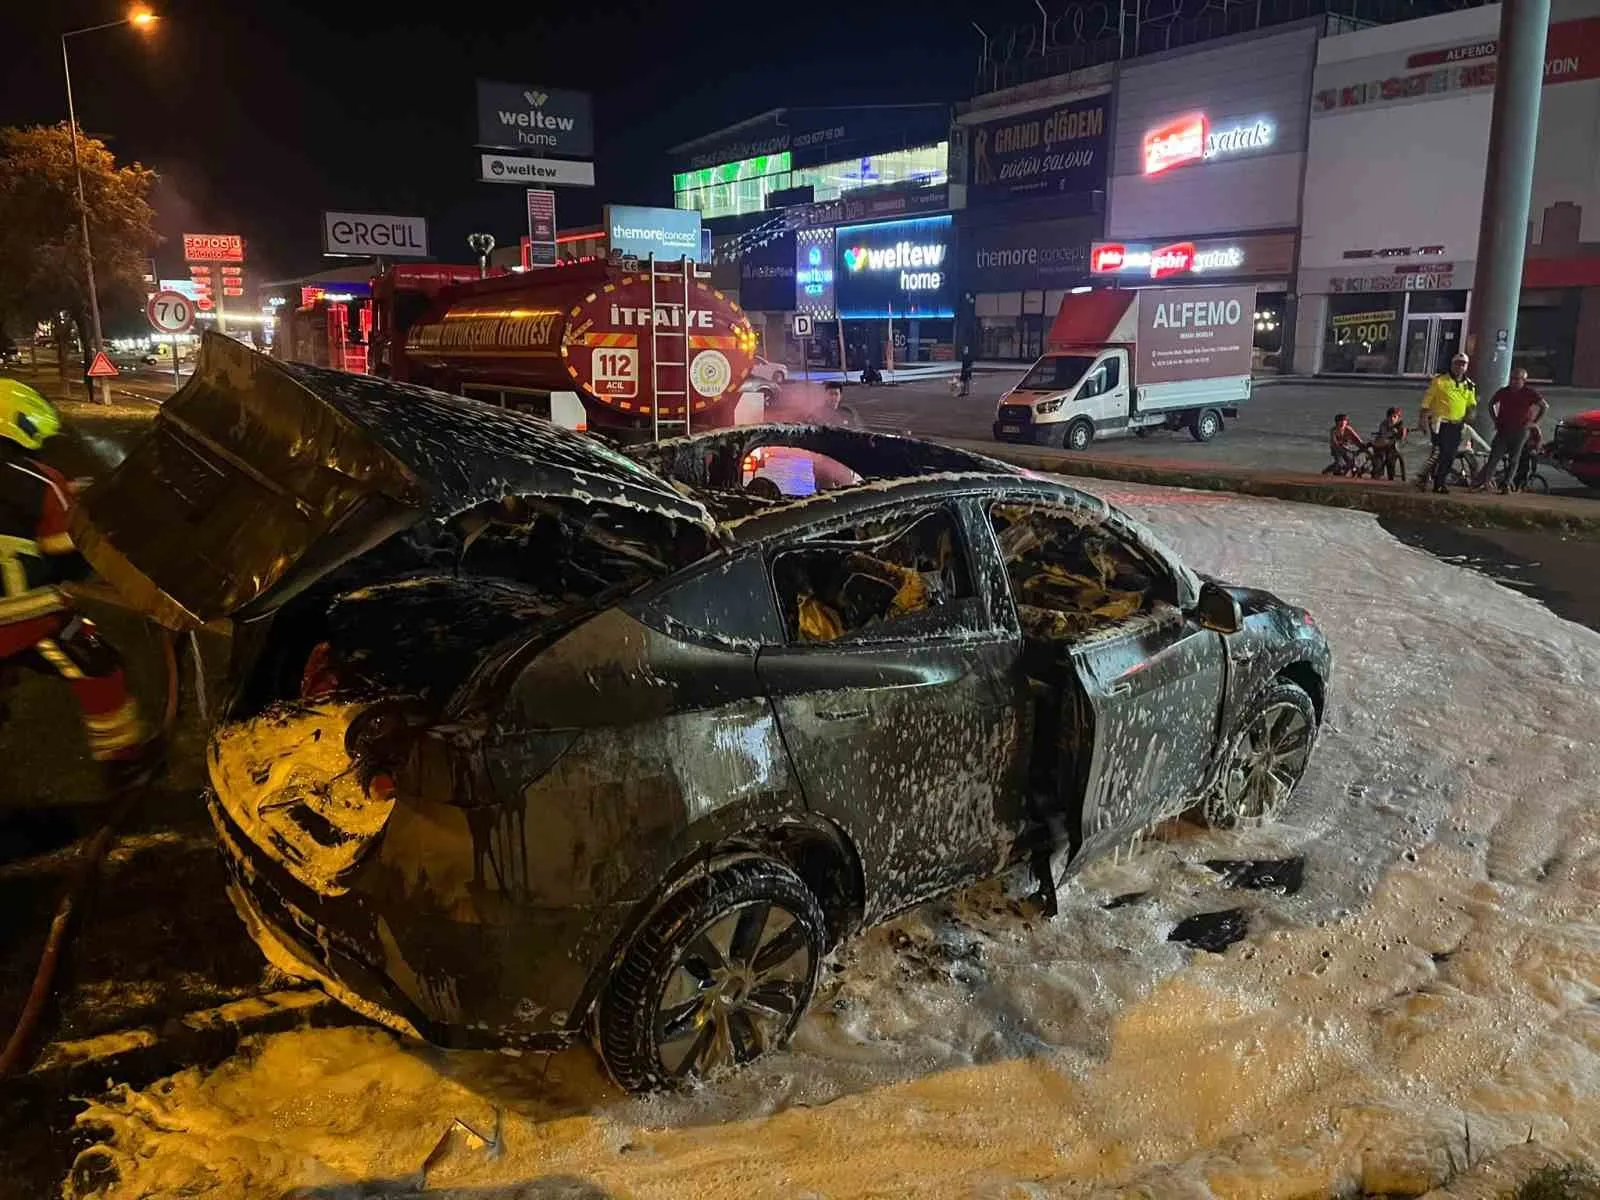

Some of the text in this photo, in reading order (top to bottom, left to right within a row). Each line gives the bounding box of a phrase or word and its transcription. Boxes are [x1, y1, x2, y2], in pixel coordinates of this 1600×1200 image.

[1446, 43, 1496, 60] ALFEMO
[498, 110, 575, 131] weltew
[517, 129, 558, 147] home
[994, 121, 1041, 153] GRAND
[505, 162, 558, 178] weltew
[867, 240, 946, 270] weltew
[900, 269, 941, 291] home
[156, 302, 187, 322] 70
[610, 304, 714, 328] İTFAİYE
[1152, 299, 1241, 329] ALFEMO
[799, 318, 809, 333] D
[599, 354, 632, 377] 112
